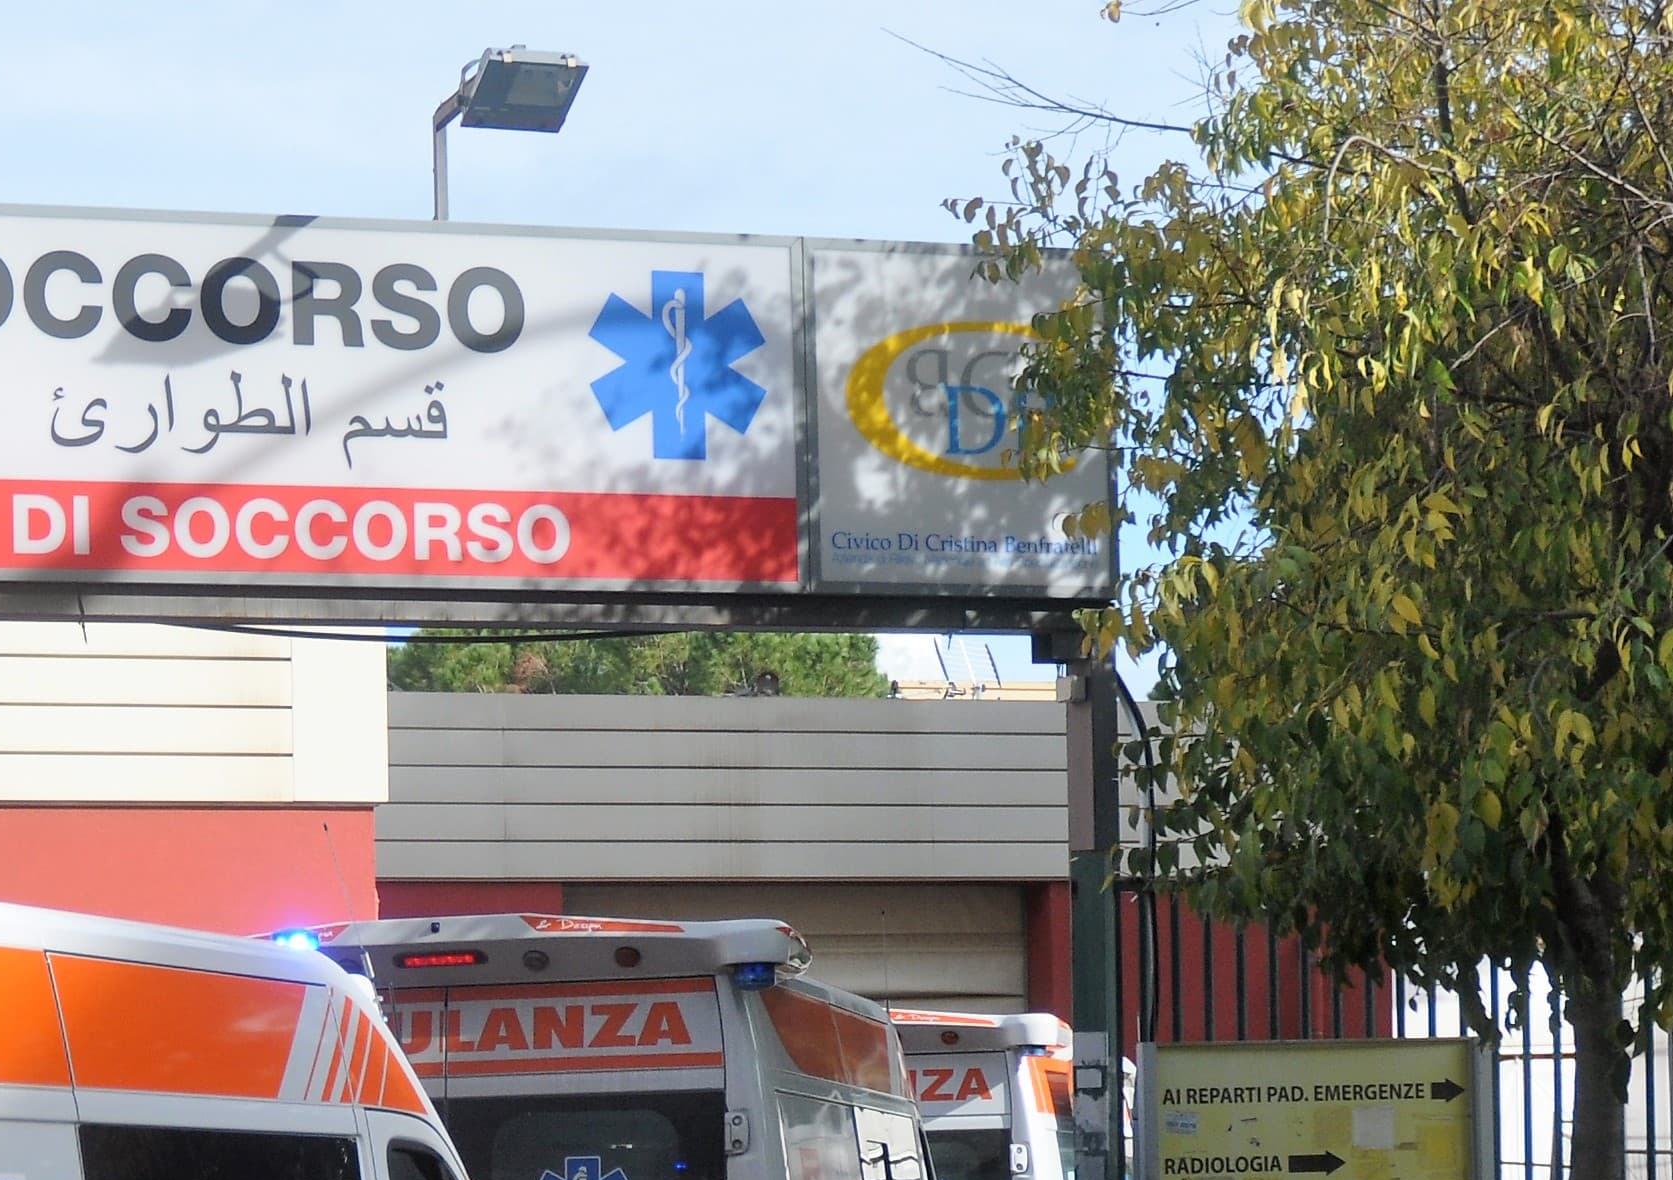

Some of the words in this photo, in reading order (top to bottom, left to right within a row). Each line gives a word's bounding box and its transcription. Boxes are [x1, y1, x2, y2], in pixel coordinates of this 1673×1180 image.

[49, 369, 313, 457] الطوارئ
[342, 379, 450, 470] قسم
[11, 495, 90, 556] DI
[120, 495, 571, 564] SOCCORSO
[831, 531, 892, 551] Civico
[897, 533, 919, 552] Di
[925, 533, 998, 553] Cristina
[1162, 1088, 1181, 1106] AI
[1186, 1086, 1262, 1105] REPARTI
[1266, 1085, 1308, 1103] PAD.
[1313, 1083, 1425, 1102] EMERGENZE
[1163, 1154, 1283, 1176] RADIOLOGIA
